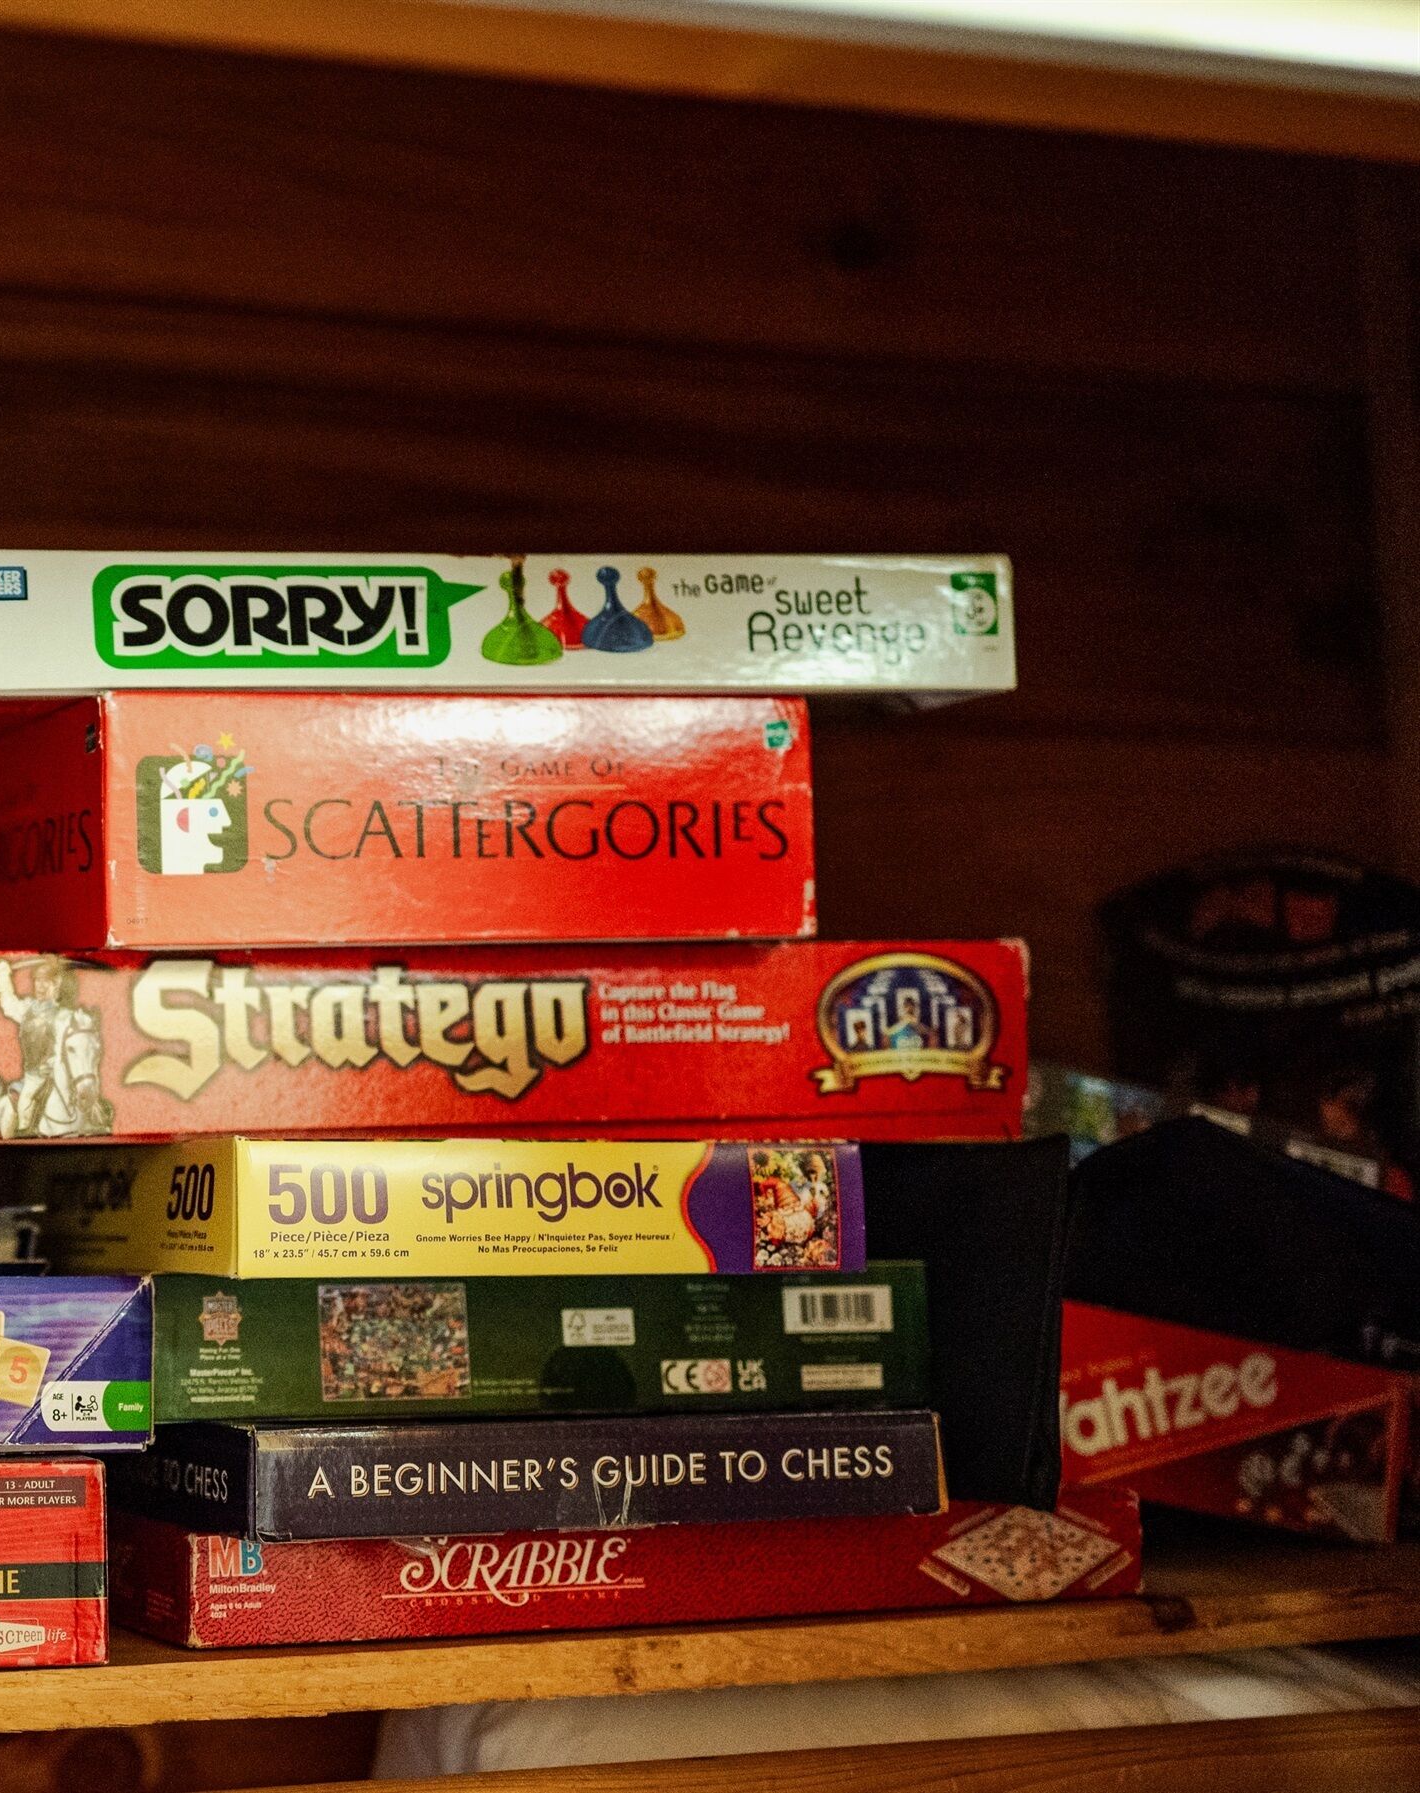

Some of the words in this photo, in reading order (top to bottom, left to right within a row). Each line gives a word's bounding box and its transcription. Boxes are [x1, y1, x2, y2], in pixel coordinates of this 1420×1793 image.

[704, 574, 764, 594] Game
[775, 576, 872, 615] sweet
[120, 584, 423, 647] SORRY!
[748, 611, 925, 665] Revenge
[263, 798, 790, 862] SCATTERGORIES
[598, 983, 666, 1003] Capture
[670, 981, 697, 1000] the
[700, 980, 737, 1004] Flag
[600, 1005, 619, 1021] in
[622, 1003, 655, 1021] this
[716, 1002, 766, 1021] Game
[123, 959, 588, 1100] Stratego
[602, 1024, 621, 1043] of
[166, 1163, 215, 1221] 500
[268, 1163, 389, 1226] 500
[422, 1162, 663, 1224] springbok
[270, 1231, 390, 1244] Piece/Pièce/Pieza
[416, 1234, 446, 1242] Gnome
[449, 1234, 482, 1242] Worries
[484, 1234, 501, 1242] Bee
[504, 1233, 531, 1244] Happy
[608, 1233, 633, 1243] Soyez
[635, 1232, 671, 1241] Heureux
[478, 1245, 490, 1253] No
[492, 1245, 510, 1253] Mas
[512, 1244, 584, 1254] Preocupaciones,
[586, 1244, 597, 1253] Se
[599, 1244, 618, 1253] Feliz
[317, 1249, 339, 1258] 45.7
[370, 1248, 391, 1257] 59.6
[8, 1355, 31, 1384] 5
[52, 1409, 67, 1421] 8+
[118, 1402, 144, 1413] Family
[4, 1480, 16, 1489] 13
[24, 1479, 56, 1489] ADULT
[184, 1462, 228, 1503] CHESS
[308, 1465, 335, 1498] A
[350, 1456, 579, 1498] BEGINNER'S
[593, 1451, 706, 1488] GUIDE
[720, 1450, 768, 1485] TO
[782, 1445, 894, 1481] CHESS
[7, 1496, 35, 1505] MORE
[38, 1495, 77, 1505] PLAYERS
[208, 1536, 263, 1578] MB
[399, 1536, 627, 1606] SCRABBLE
